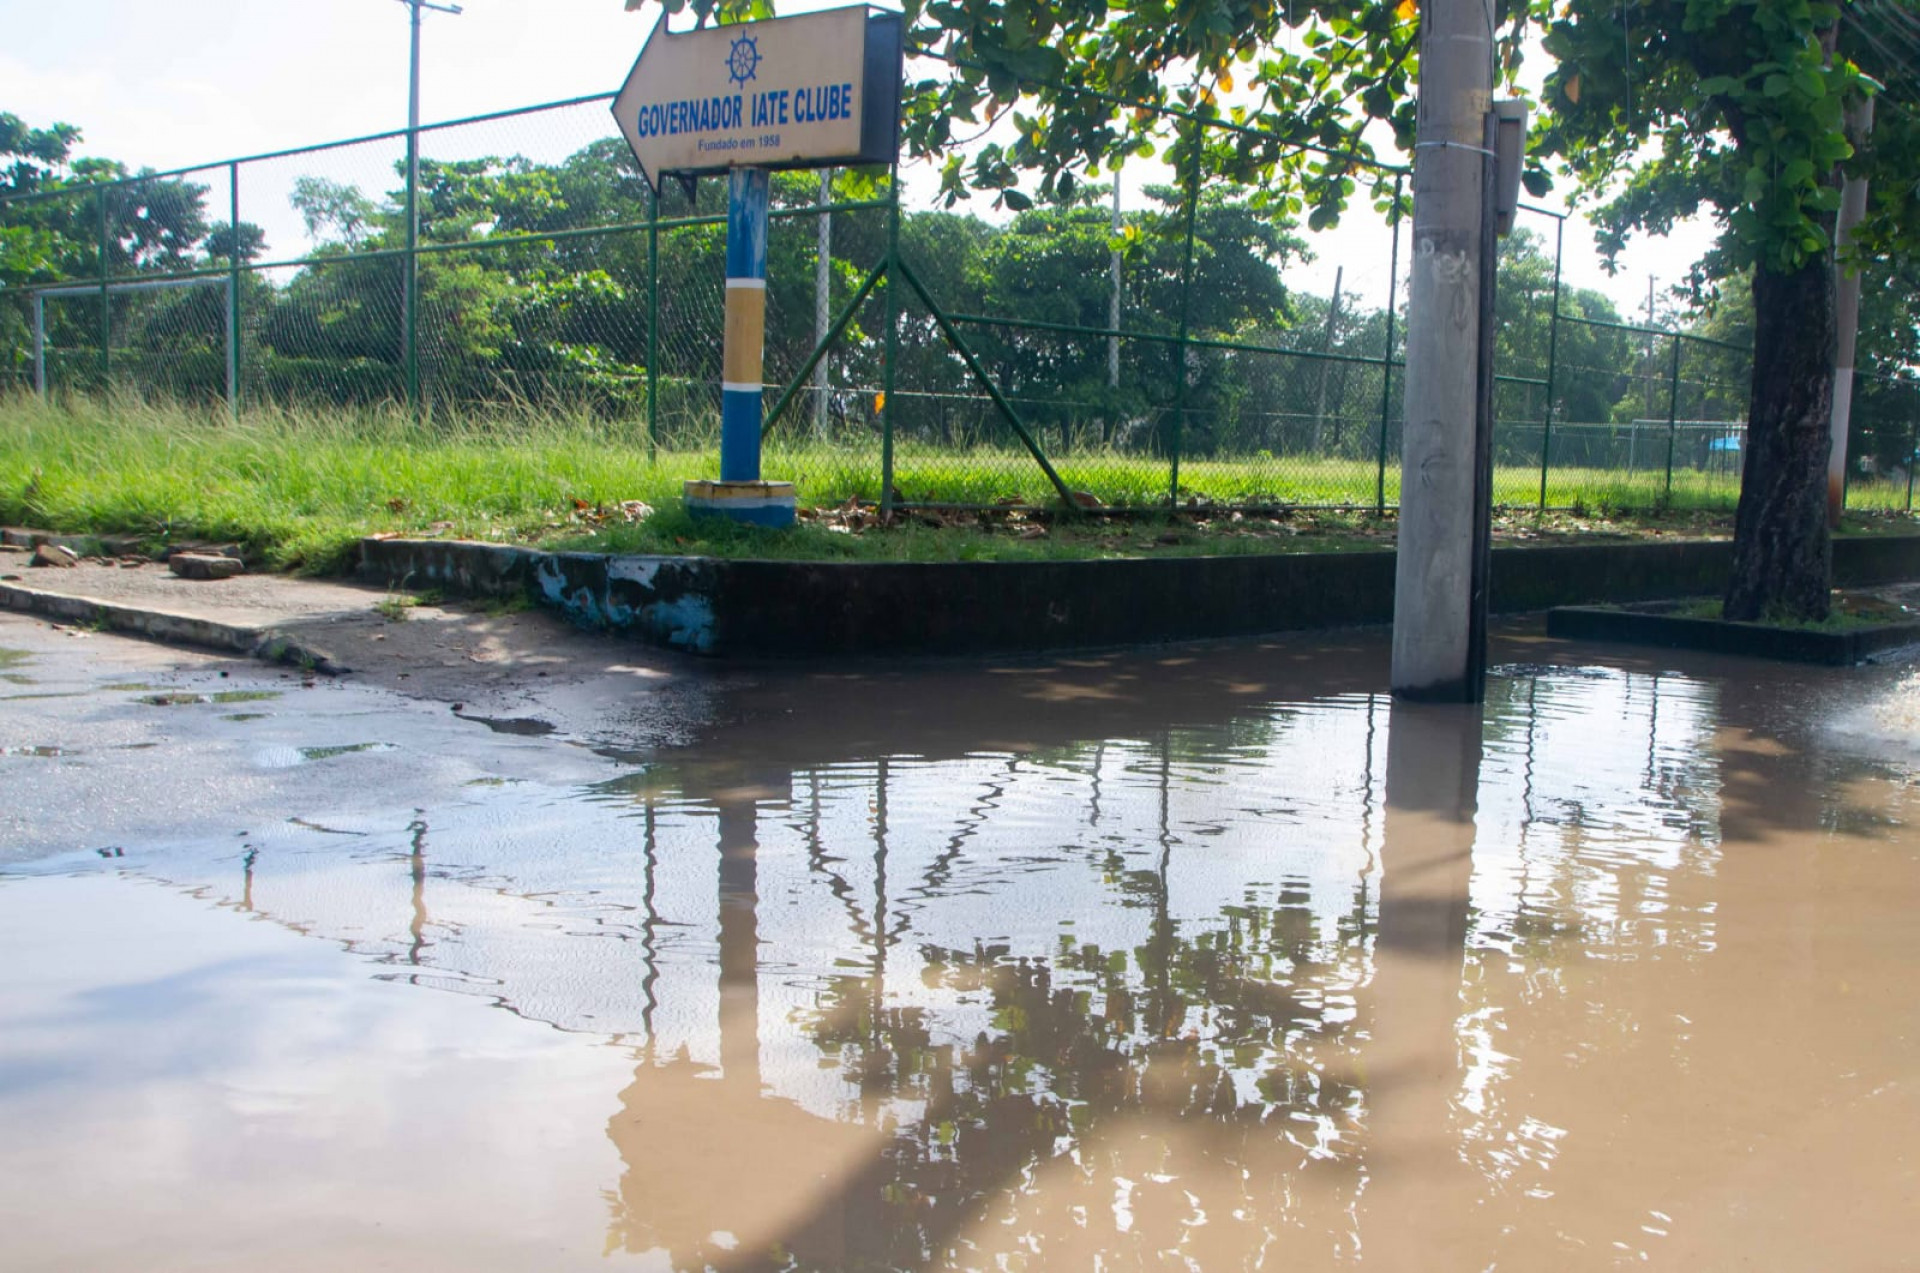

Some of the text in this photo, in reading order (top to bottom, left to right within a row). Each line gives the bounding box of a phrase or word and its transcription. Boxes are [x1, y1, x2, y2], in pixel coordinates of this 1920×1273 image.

[638, 83, 852, 138] GOVERNADOR IATE CLUBE
[698, 135, 780, 151] Fundado em 1958
